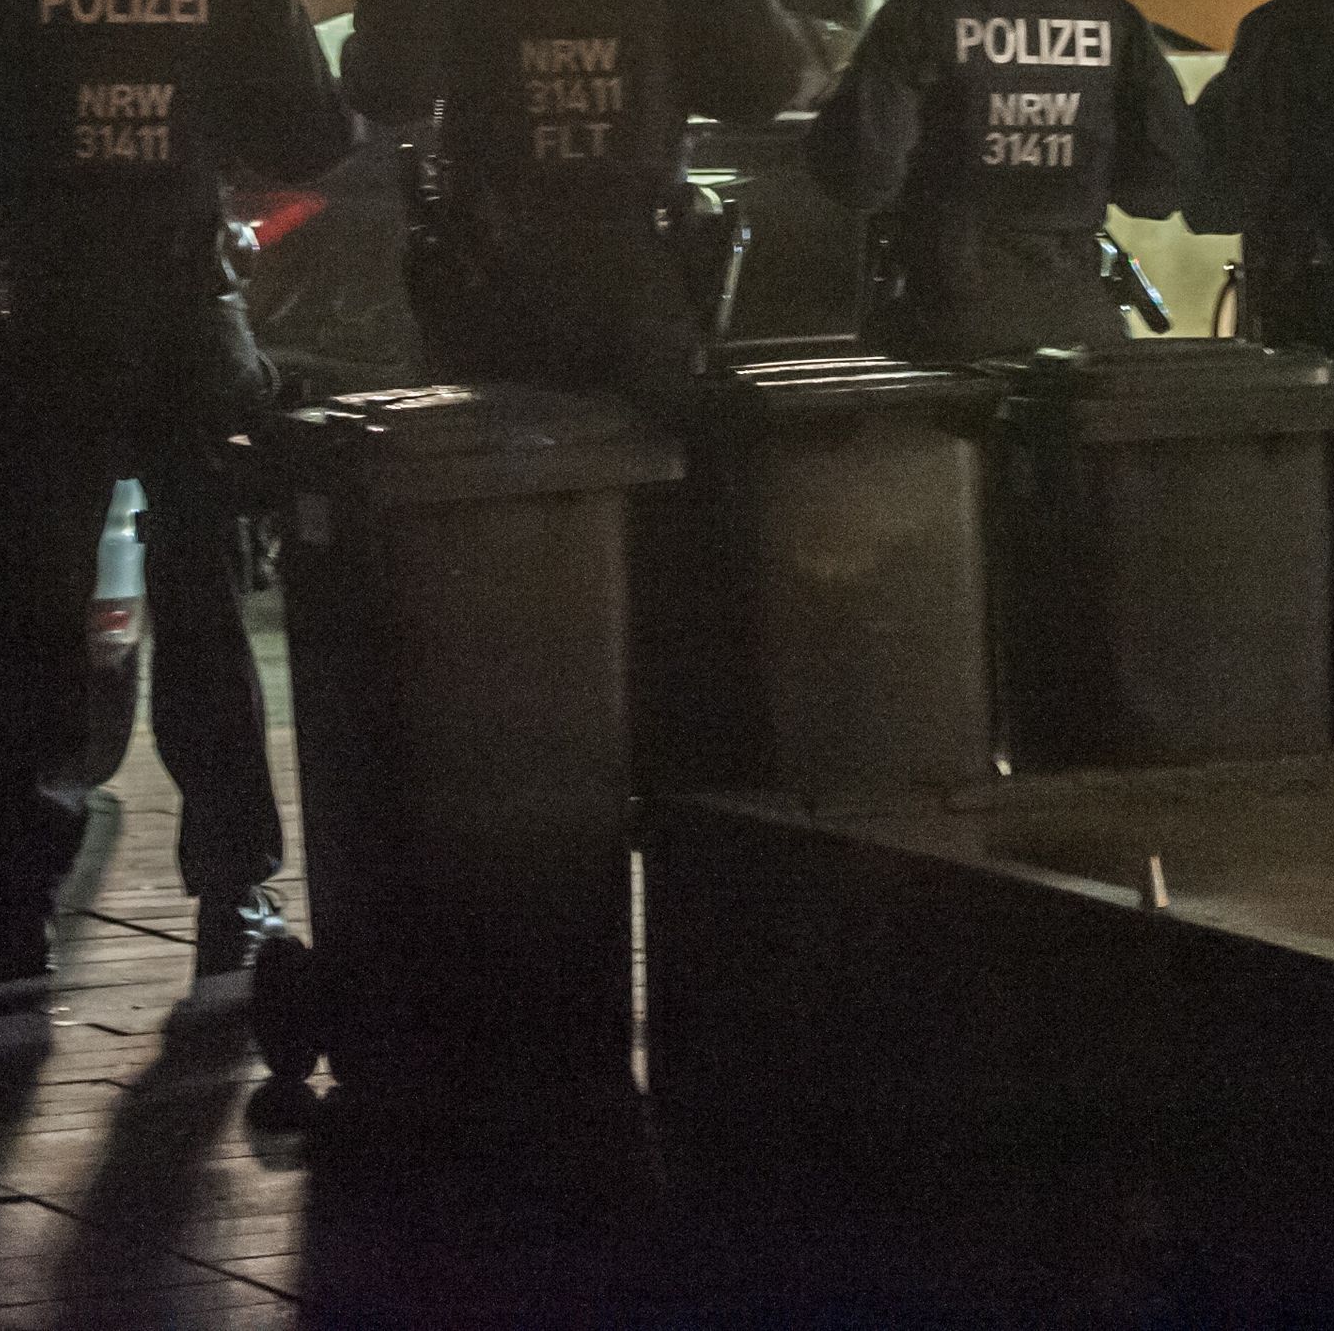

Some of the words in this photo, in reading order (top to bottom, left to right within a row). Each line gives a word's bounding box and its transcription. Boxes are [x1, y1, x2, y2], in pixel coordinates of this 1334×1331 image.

[520, 38, 620, 72] NRW
[955, 17, 1112, 67] POLIZEI
[78, 83, 175, 118] NRW
[524, 77, 624, 115] 31411
[989, 92, 1082, 126] NRW
[74, 124, 170, 160] 31411
[534, 122, 614, 160] FLT
[982, 132, 1075, 167] 31411
